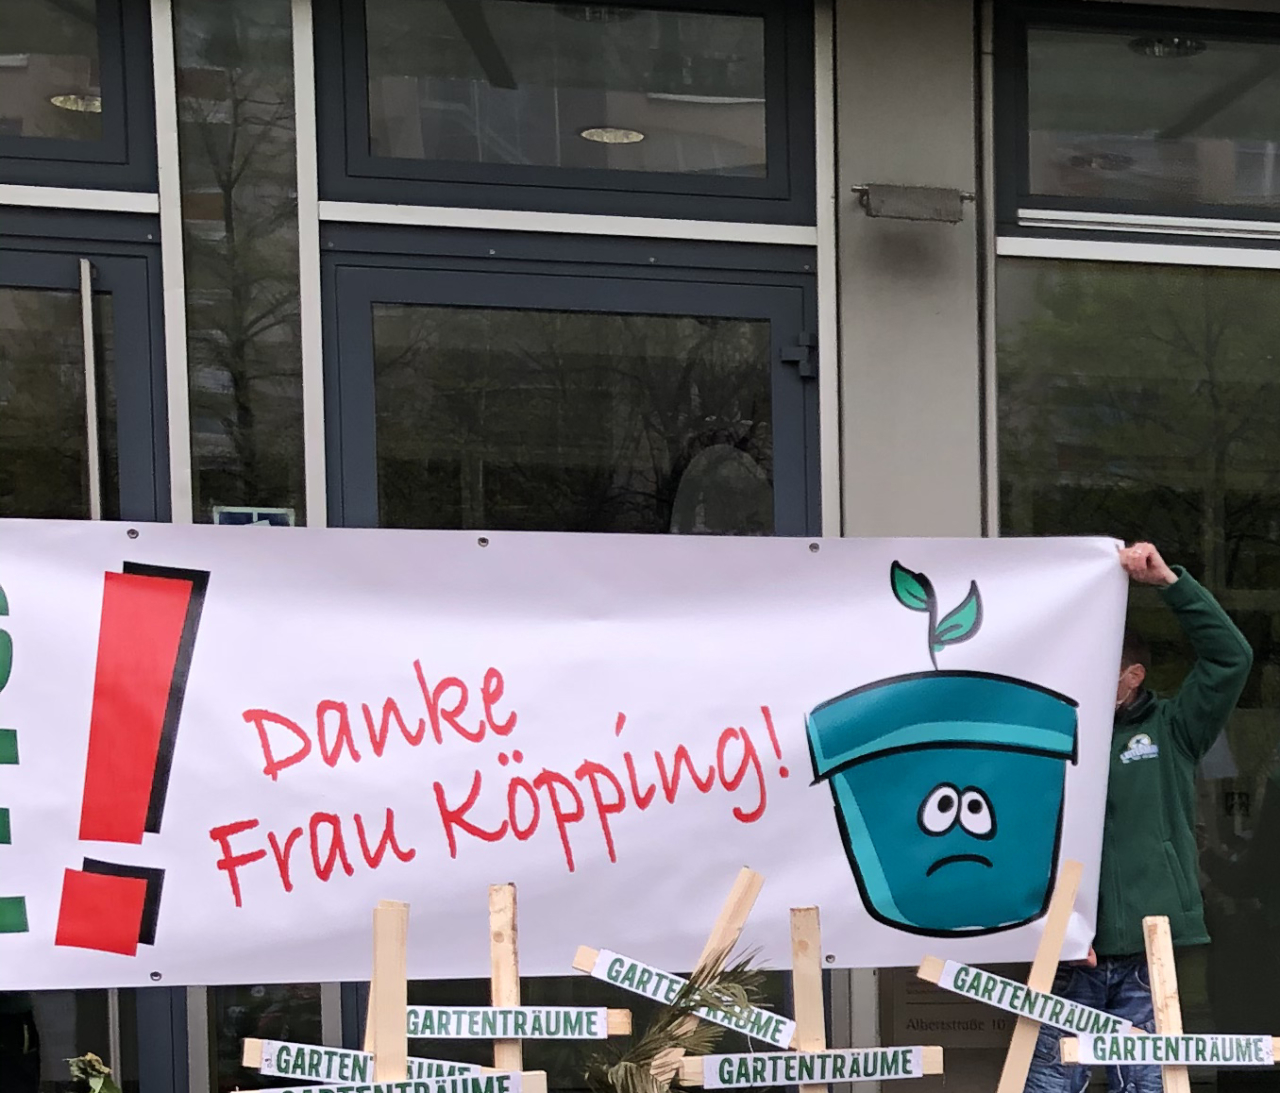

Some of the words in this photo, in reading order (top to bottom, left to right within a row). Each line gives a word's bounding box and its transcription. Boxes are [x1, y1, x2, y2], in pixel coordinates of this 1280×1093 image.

[242, 658, 518, 781] Danke
[209, 806, 417, 908] Frau
[432, 705, 791, 873] Köpping!
[407, 1008, 598, 1036] GARTENTRÄUME
[606, 957, 787, 1043] GARTEUME
[953, 966, 1123, 1034] GARTENTRÄUME
[719, 1049, 914, 1085] GARTENTRÄUME
[1093, 1036, 1265, 1062] GARTENTRÄUME
